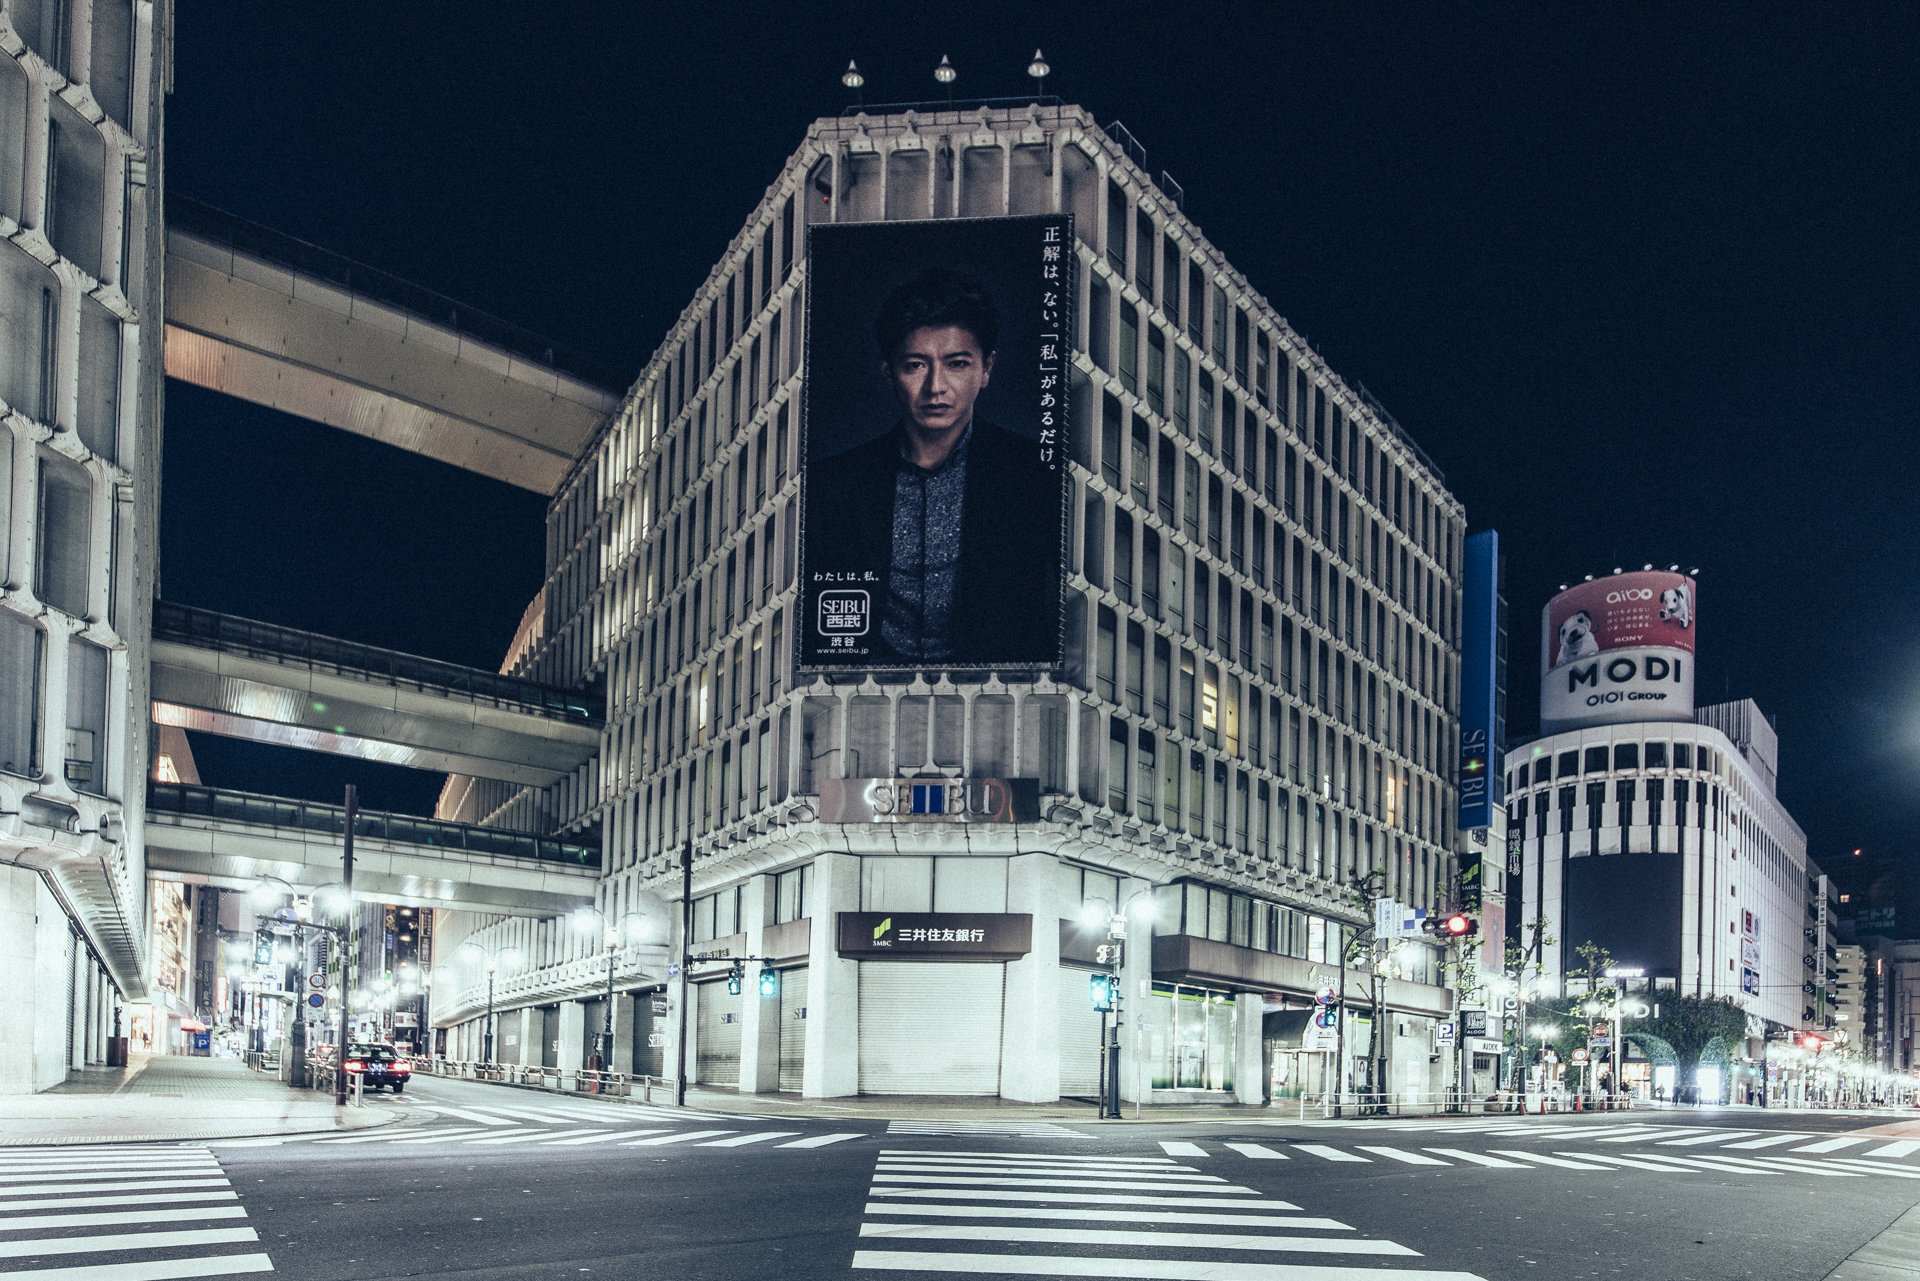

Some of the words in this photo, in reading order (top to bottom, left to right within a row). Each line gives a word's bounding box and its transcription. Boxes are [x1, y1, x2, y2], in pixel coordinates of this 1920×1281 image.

[1039, 226, 1061, 471] 正解は、ない。「私」があるだけ。
[813, 570, 880, 582] わたしは、私。
[1606, 588, 1653, 604] aibo
[822, 599, 866, 614] SEIBU
[826, 614, 861, 628] 西武
[831, 636, 855, 647] 渋谷
[1614, 635, 1643, 643] SONY
[816, 647, 869, 655] www.seibu.jp
[1568, 657, 1681, 693] MODI
[1461, 729, 1485, 810] SEIBU
[873, 784, 995, 815] SEIBU
[1508, 828, 1521, 876] 眼鏡市場
[898, 928, 985, 942] 三井住友銀行
